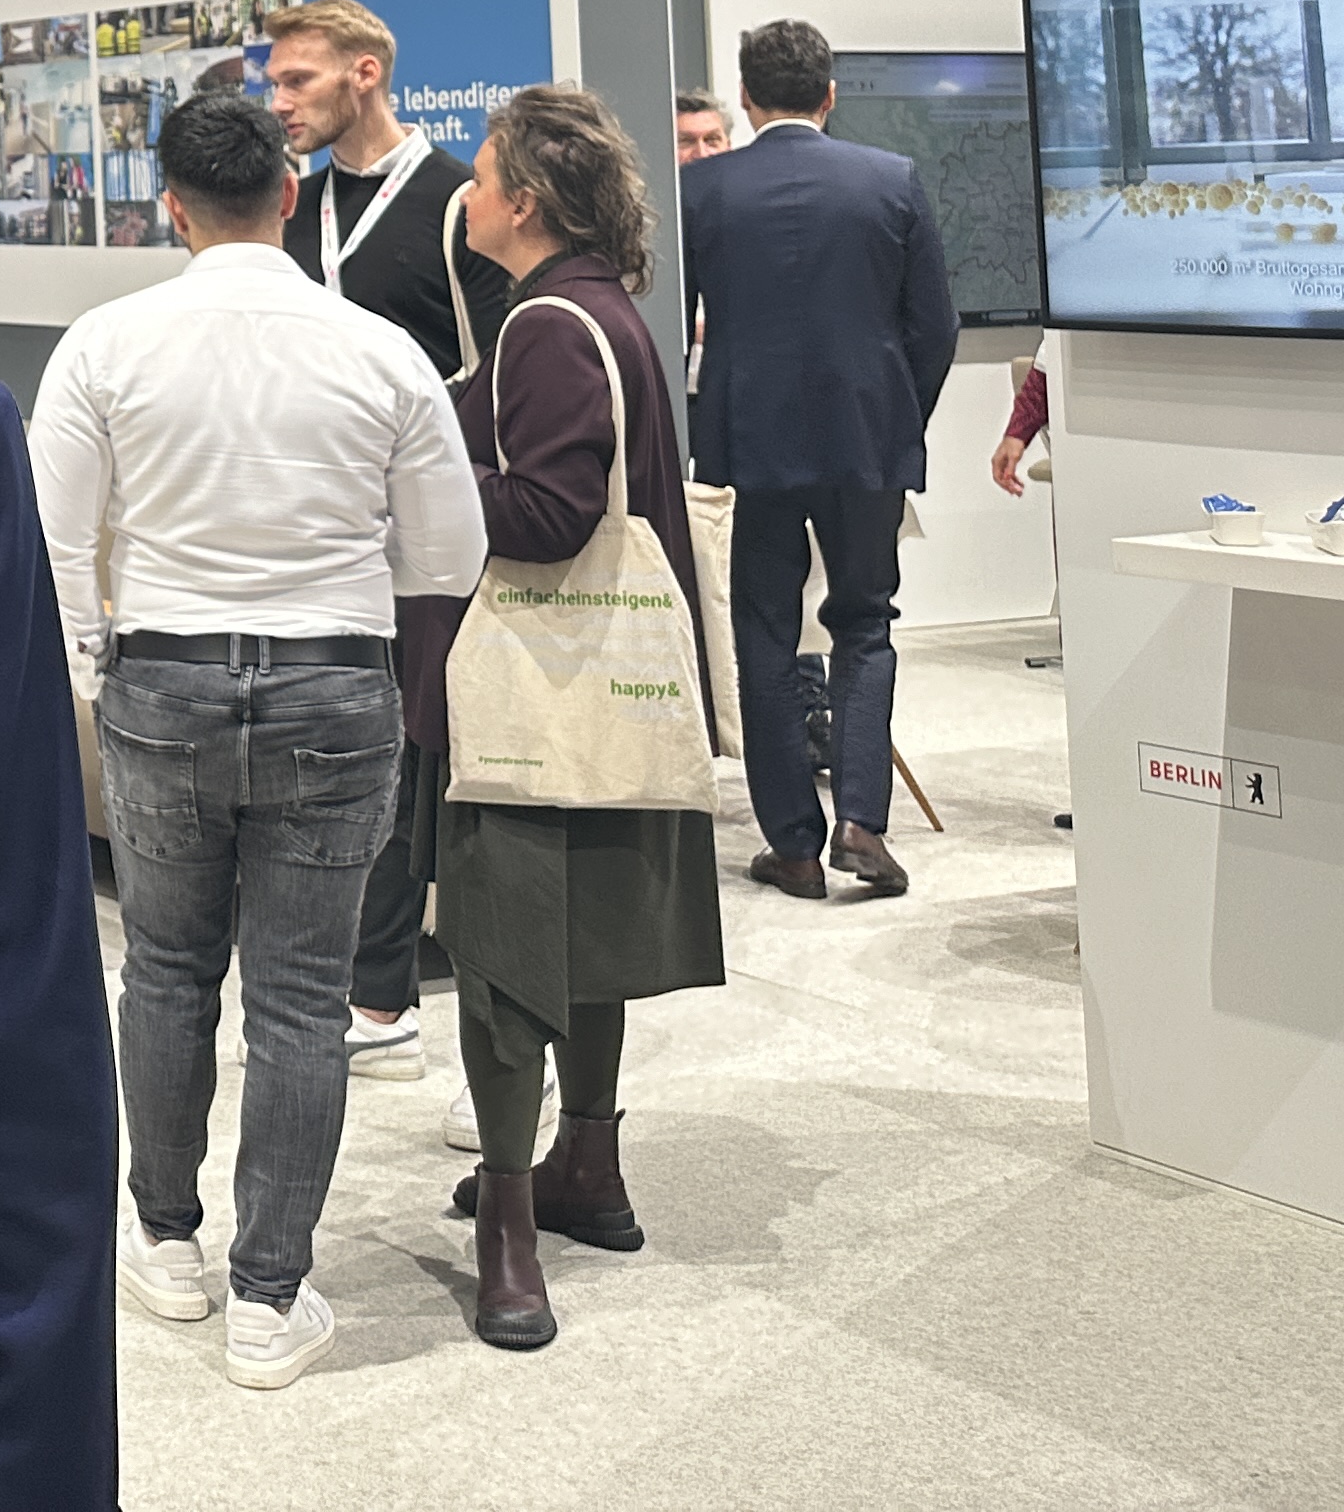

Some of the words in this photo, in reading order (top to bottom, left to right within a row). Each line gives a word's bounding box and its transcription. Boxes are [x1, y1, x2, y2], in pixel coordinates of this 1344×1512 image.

[404, 80, 529, 114] lebendige
[1290, 281, 1344, 299] Wohng
[610, 678, 680, 700] happy&
[1149, 759, 1222, 791] BERLIN
